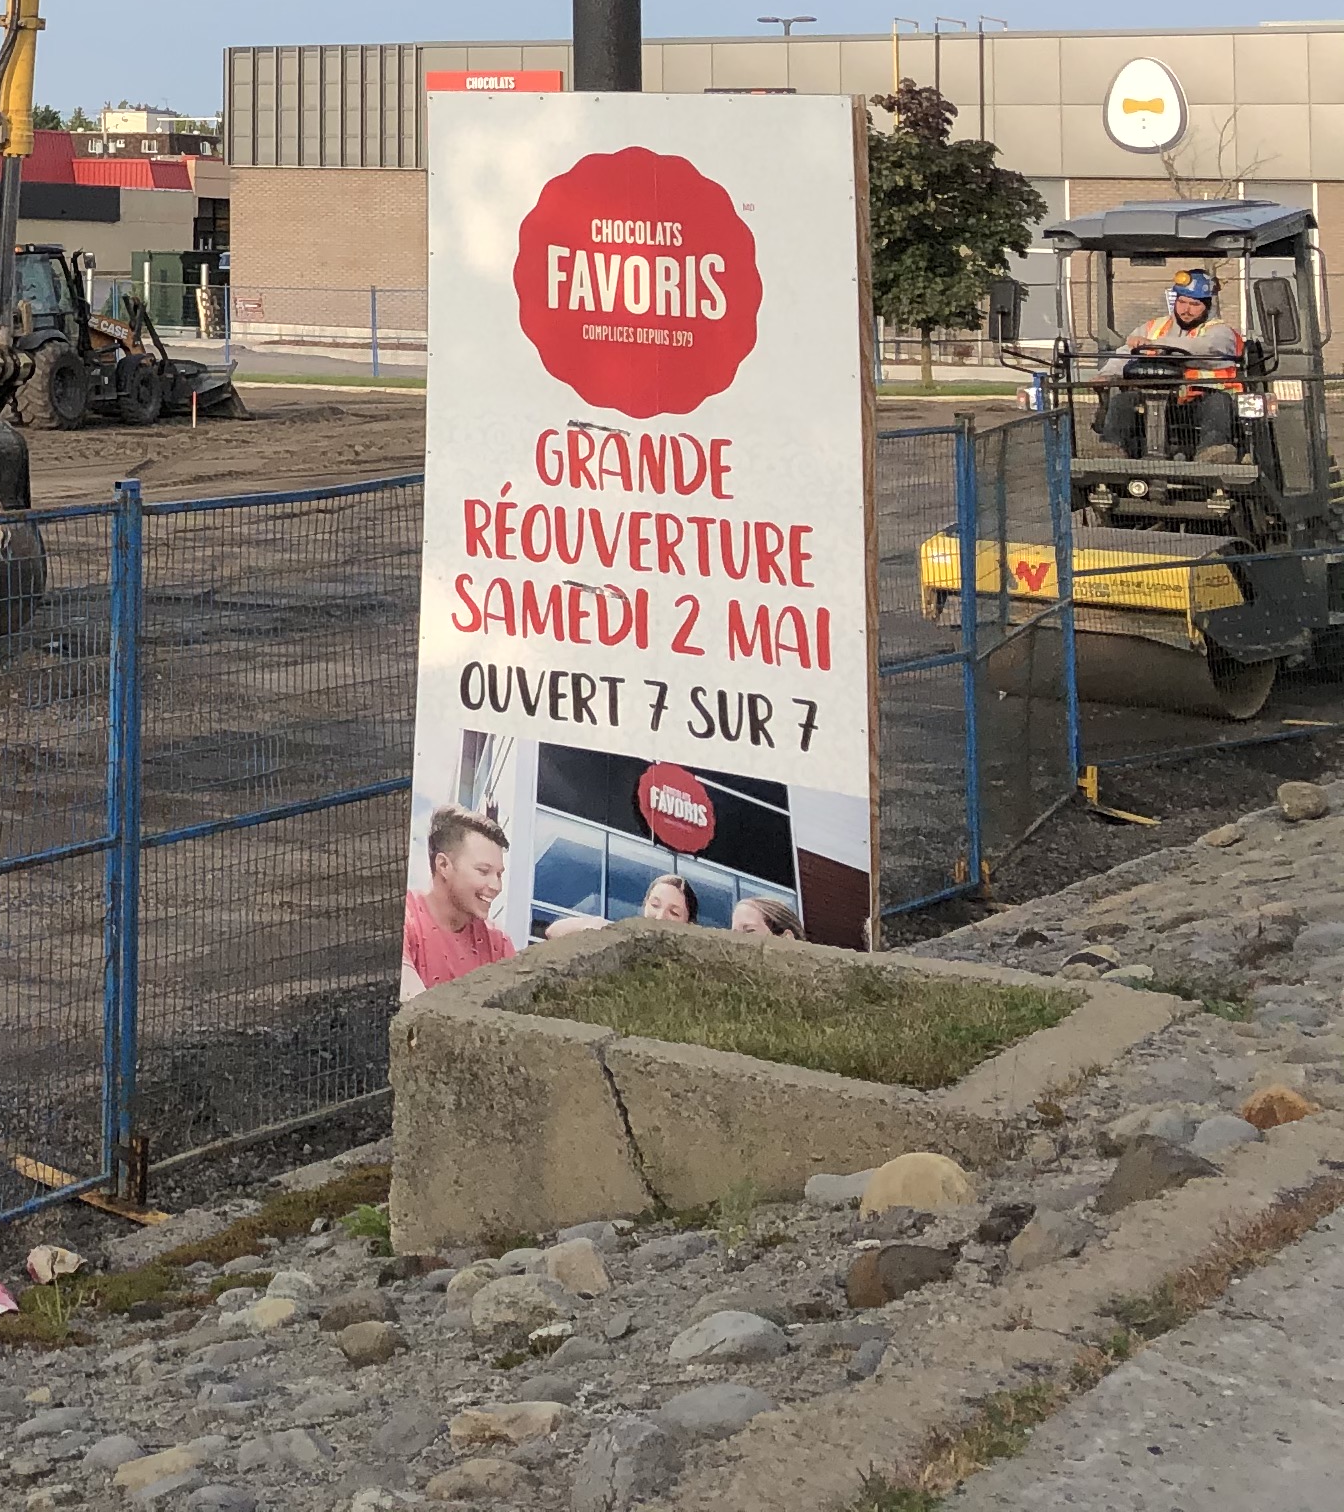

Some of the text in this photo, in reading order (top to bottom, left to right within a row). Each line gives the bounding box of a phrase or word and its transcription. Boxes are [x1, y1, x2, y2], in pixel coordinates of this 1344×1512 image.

[465, 76, 515, 90] CHOCOLATS
[590, 218, 683, 247] CHOCOLATS
[547, 244, 728, 320] FAVORIS
[100, 320, 129, 340] CASE
[582, 324, 693, 347] COMPLICES DEPUIS 1979
[535, 427, 734, 500] GRANDE
[463, 481, 815, 588] RÉOUVERTURE
[451, 573, 832, 671] SAMEDI 2 MAI
[459, 660, 820, 752] OUVERT 7 SUR 7
[649, 784, 708, 828] FAVORIS
